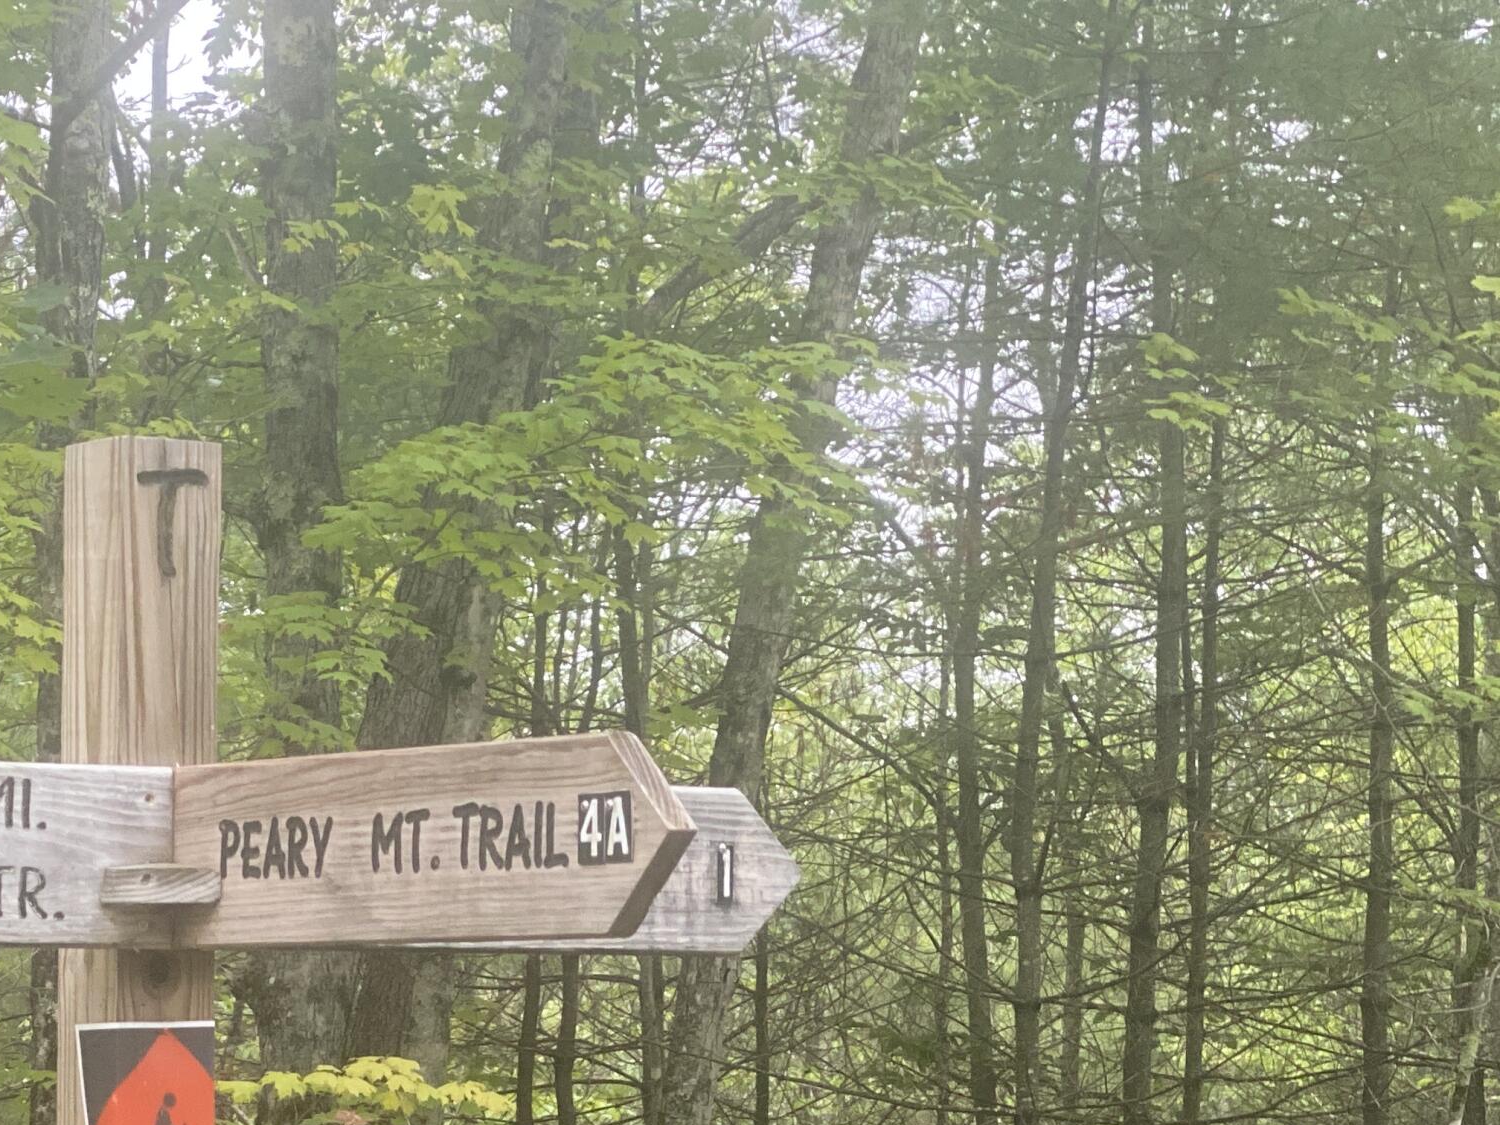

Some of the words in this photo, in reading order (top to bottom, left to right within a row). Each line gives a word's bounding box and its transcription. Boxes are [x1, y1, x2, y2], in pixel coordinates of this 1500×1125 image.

[137, 468, 210, 577] T
[219, 816, 333, 879] PEARY
[371, 808, 441, 874] MT.
[453, 801, 569, 870] TRAIL
[580, 796, 630, 858] 4A
